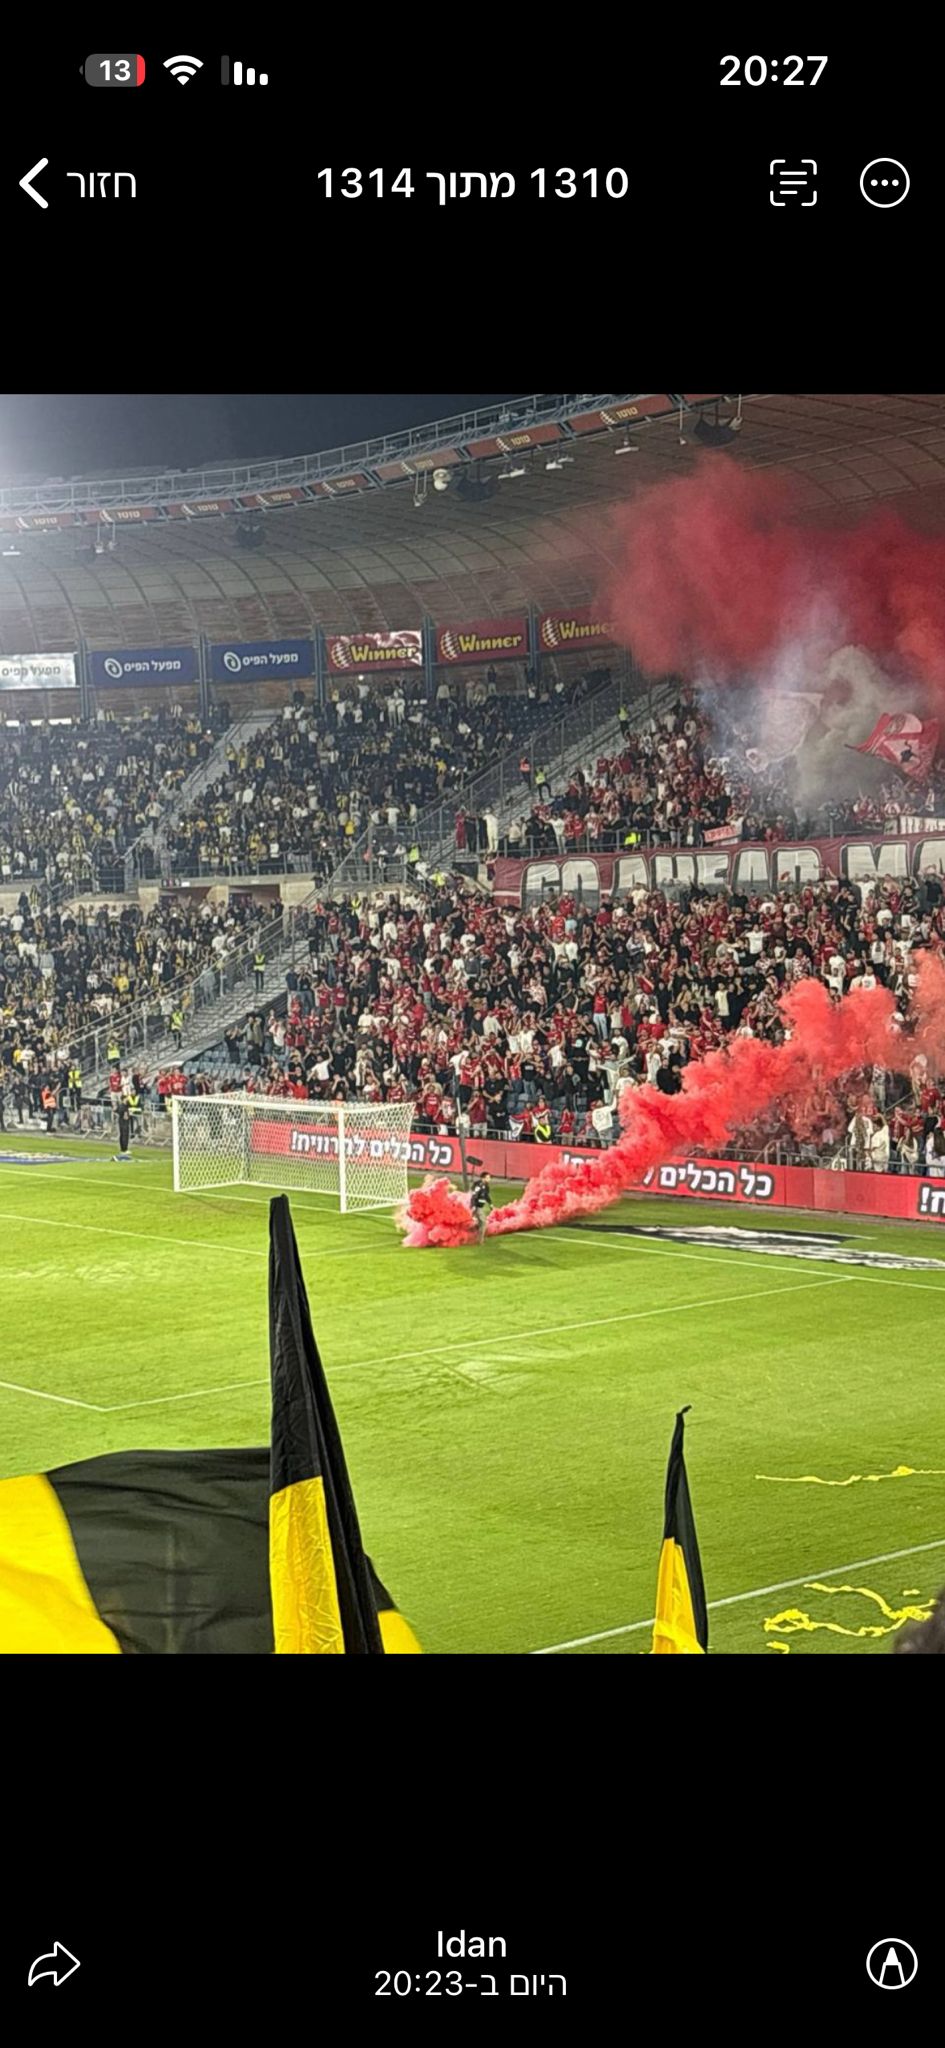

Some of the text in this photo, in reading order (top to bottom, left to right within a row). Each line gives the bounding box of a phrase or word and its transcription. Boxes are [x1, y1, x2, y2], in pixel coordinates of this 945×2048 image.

[350, 644, 417, 663] Winner
[458, 633, 523, 652] Winner
[124, 659, 182, 673] מפעל הפיס
[242, 651, 299, 667] מפעל הפיס
[521, 857, 600, 911] GO
[611, 843, 821, 898] AHEAD
[369, 1136, 425, 1163] הכלים
[428, 1139, 453, 1166] כל
[659, 1162, 735, 1193] הכלים
[739, 1166, 773, 1197] כל
